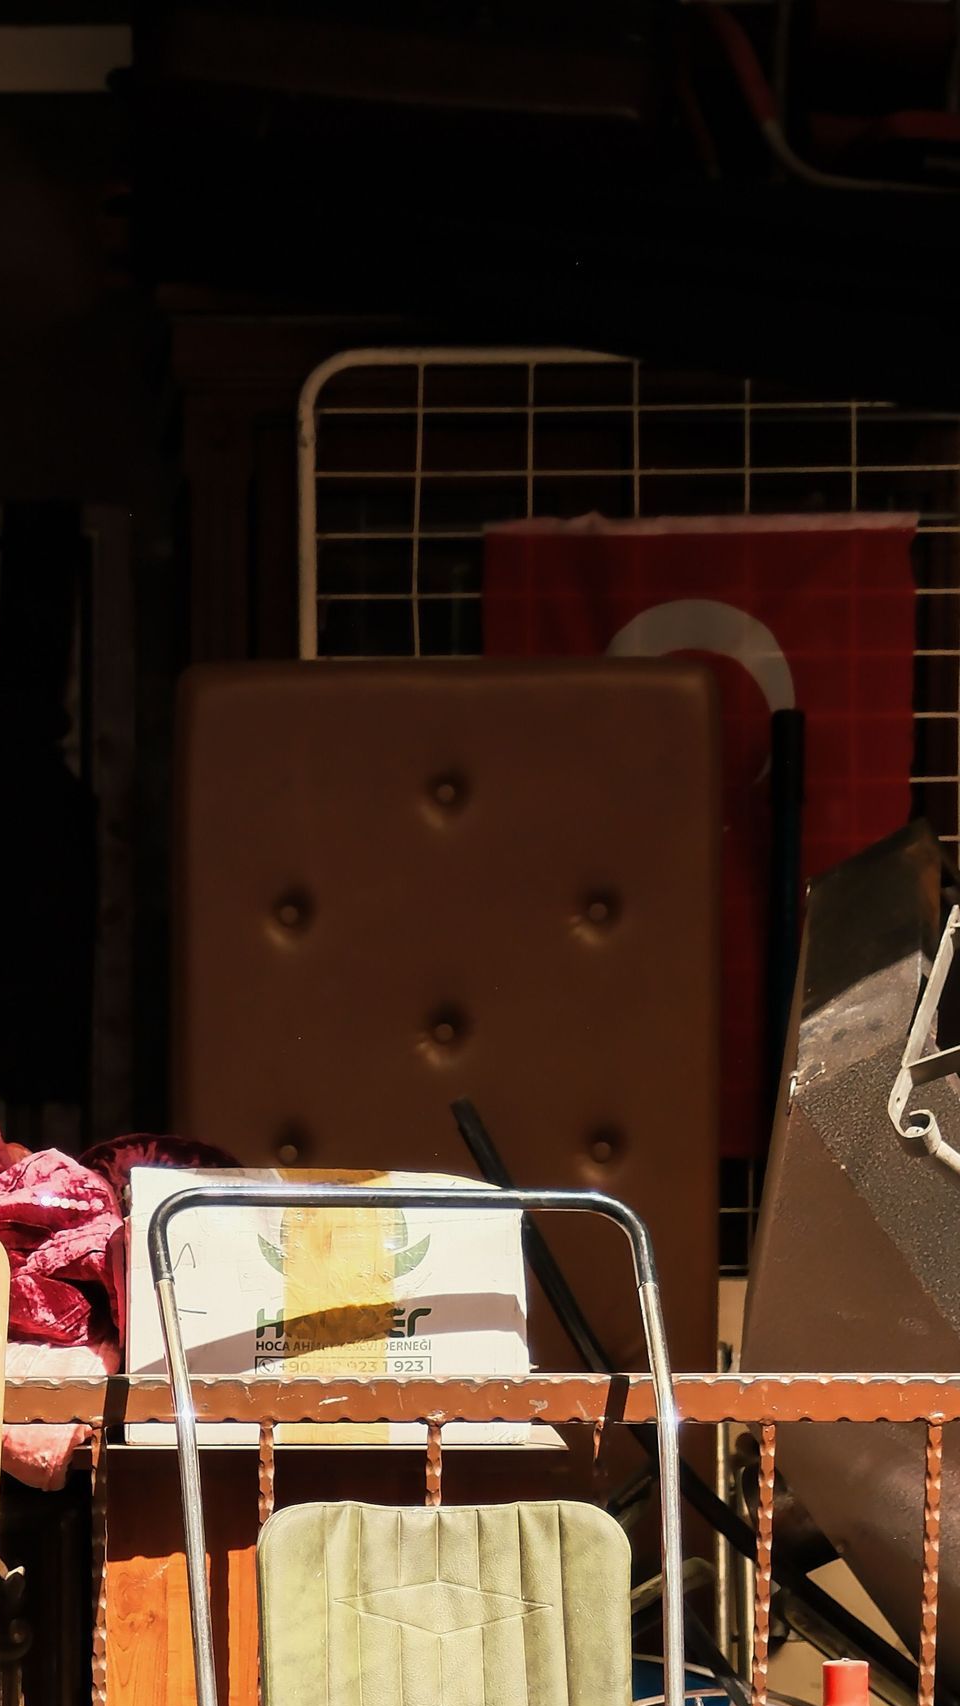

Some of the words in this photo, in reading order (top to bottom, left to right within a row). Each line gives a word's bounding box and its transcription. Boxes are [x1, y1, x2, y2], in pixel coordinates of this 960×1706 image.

[256, 1341, 290, 1352] HOCA
[293, 1341, 335, 1352] AHM
[279, 1360, 310, 1374] +90
[383, 1360, 389, 1374] 1
[394, 1360, 424, 1373] 923
